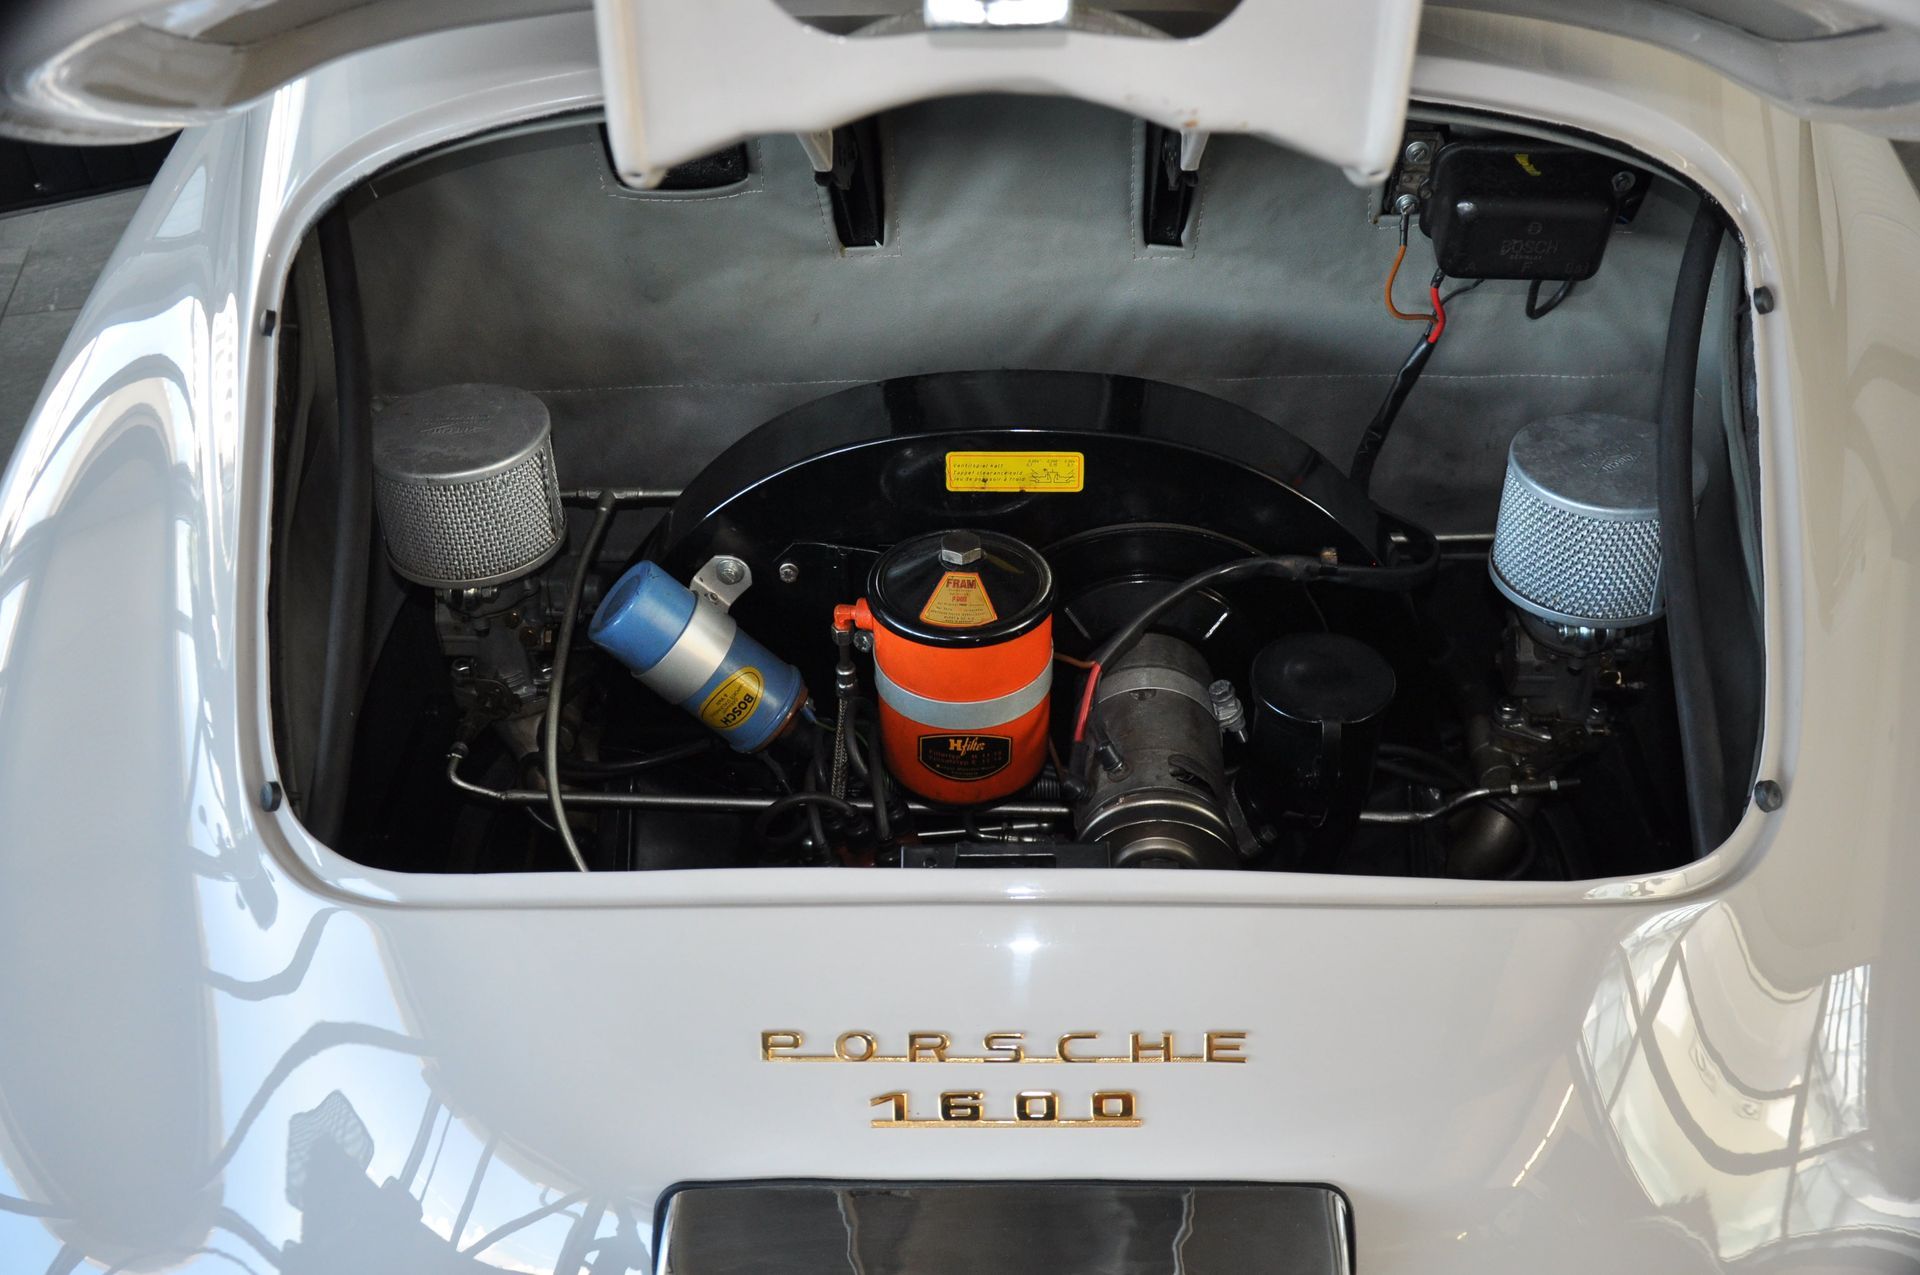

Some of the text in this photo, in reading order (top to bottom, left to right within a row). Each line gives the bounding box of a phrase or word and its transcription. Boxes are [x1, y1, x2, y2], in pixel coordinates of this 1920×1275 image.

[1499, 239, 1559, 256] BOSCH
[946, 578, 977, 589] FRAM
[720, 693, 755, 726] BOSCH
[760, 1030, 1247, 1063] PORSCHE
[869, 1090, 1139, 1124] 1600
